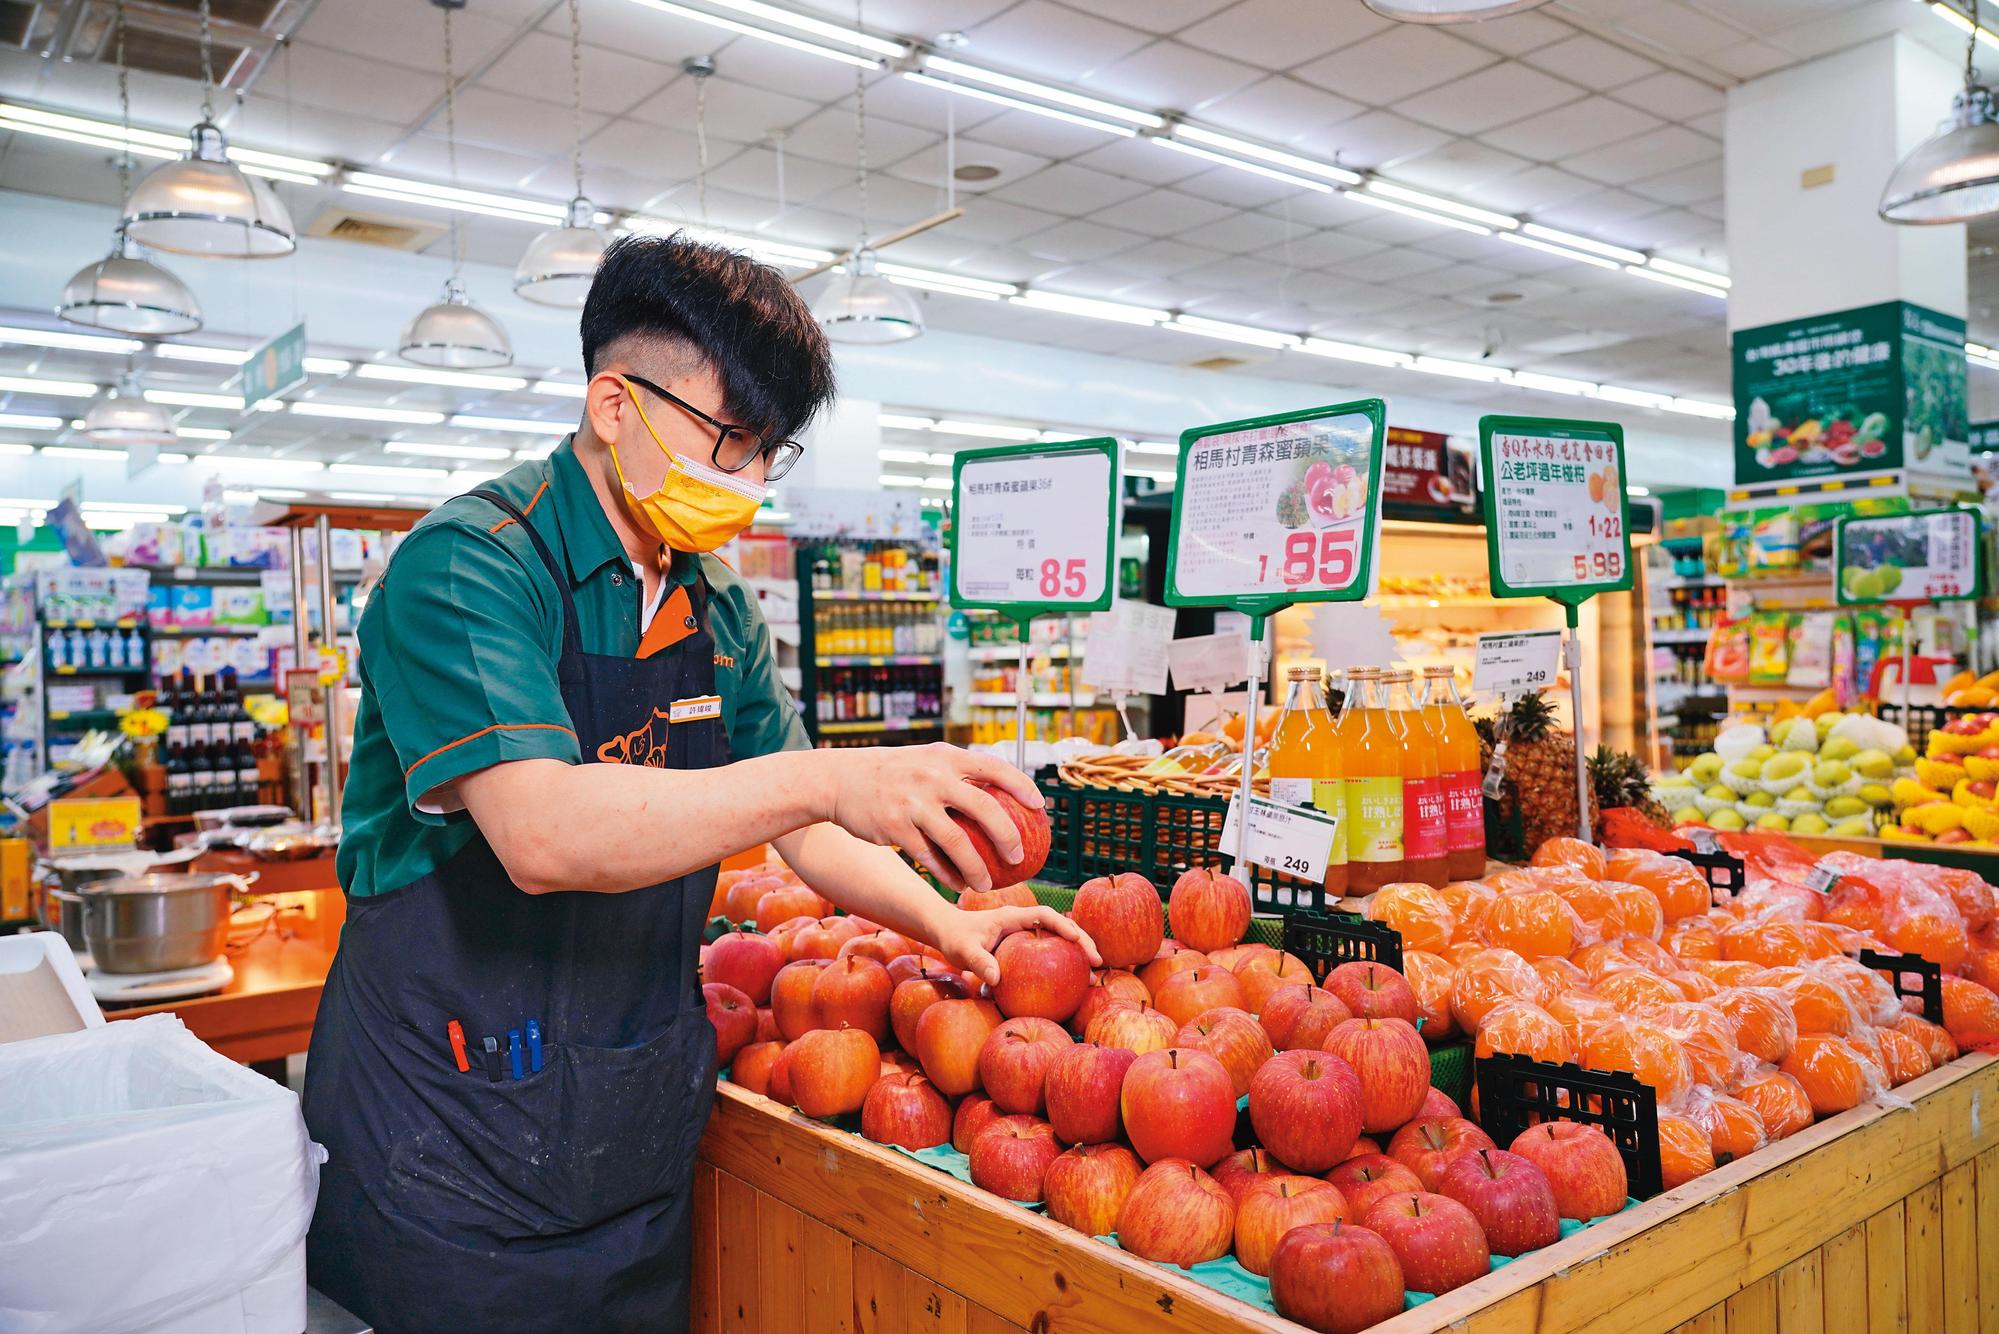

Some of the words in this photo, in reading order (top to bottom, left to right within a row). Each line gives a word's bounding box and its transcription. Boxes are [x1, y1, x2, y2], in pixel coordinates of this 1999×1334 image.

[1194, 434, 1329, 471] 相馬村青森蜜蘋果
[1283, 530, 1355, 585] 85
[1039, 558, 1087, 598] 85
[1526, 670, 1546, 683] 249
[1283, 855, 1310, 874] 249
